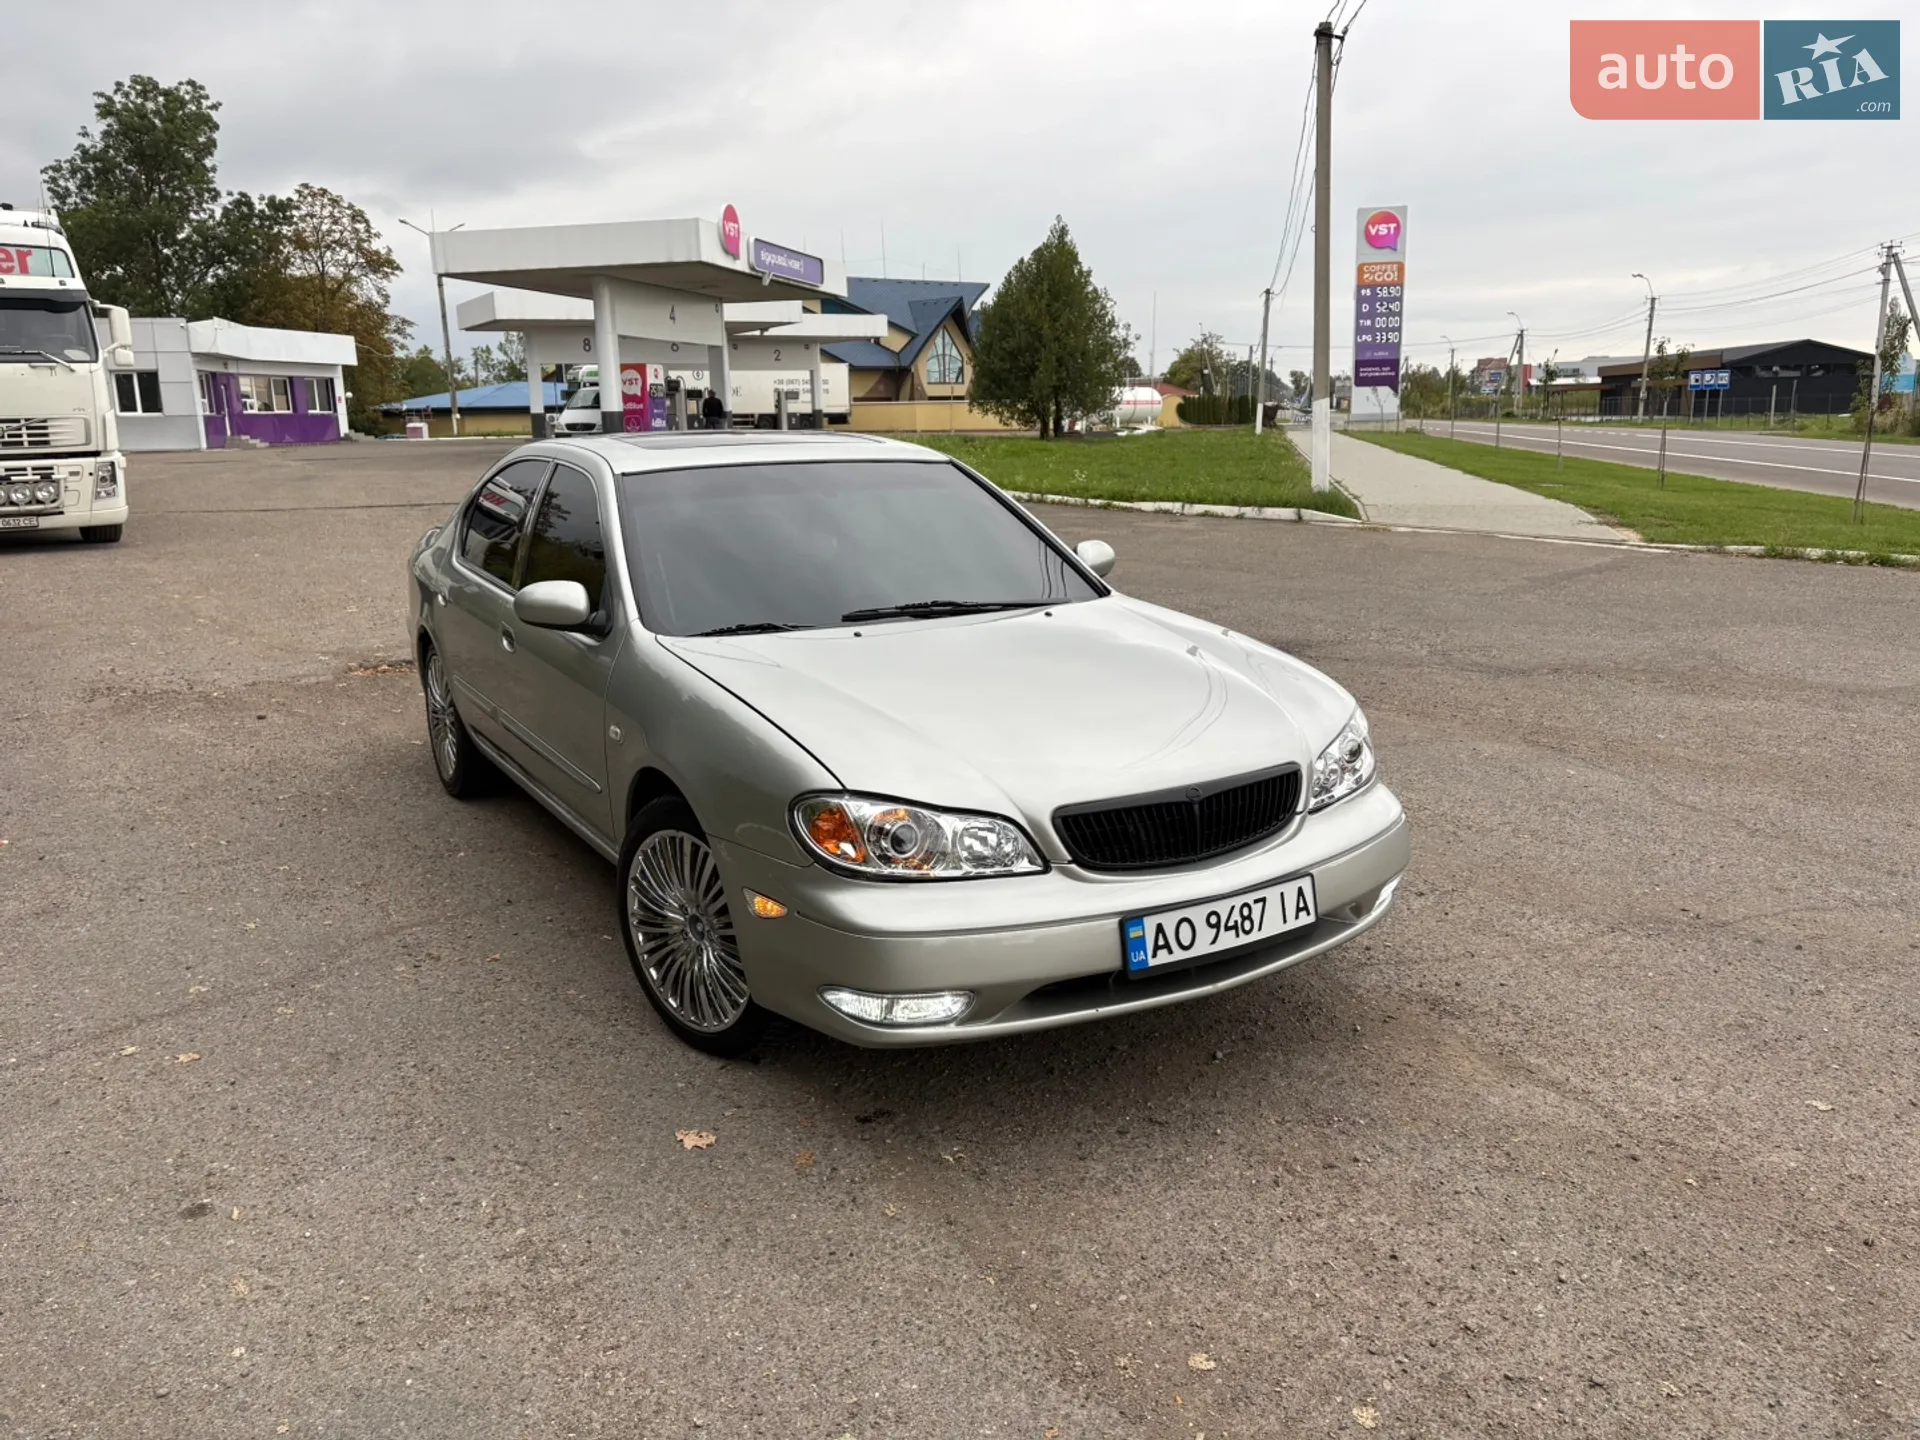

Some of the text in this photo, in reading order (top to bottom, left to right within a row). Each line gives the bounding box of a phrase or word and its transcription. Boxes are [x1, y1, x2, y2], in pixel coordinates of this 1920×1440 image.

[724, 221, 739, 238] VST
[1368, 223, 1397, 236] VST
[1363, 264, 1398, 272] COFFEE
[1374, 271, 1398, 281] GO!
[669, 304, 676, 324] 4
[1362, 303, 1370, 312] D
[1357, 334, 1372, 342] LPG
[582, 338, 592, 352] 8
[773, 349, 782, 362] 2
[622, 377, 640, 386] VST
[1151, 885, 1312, 959] AO 9487 IA
[1131, 949, 1146, 963] UA
